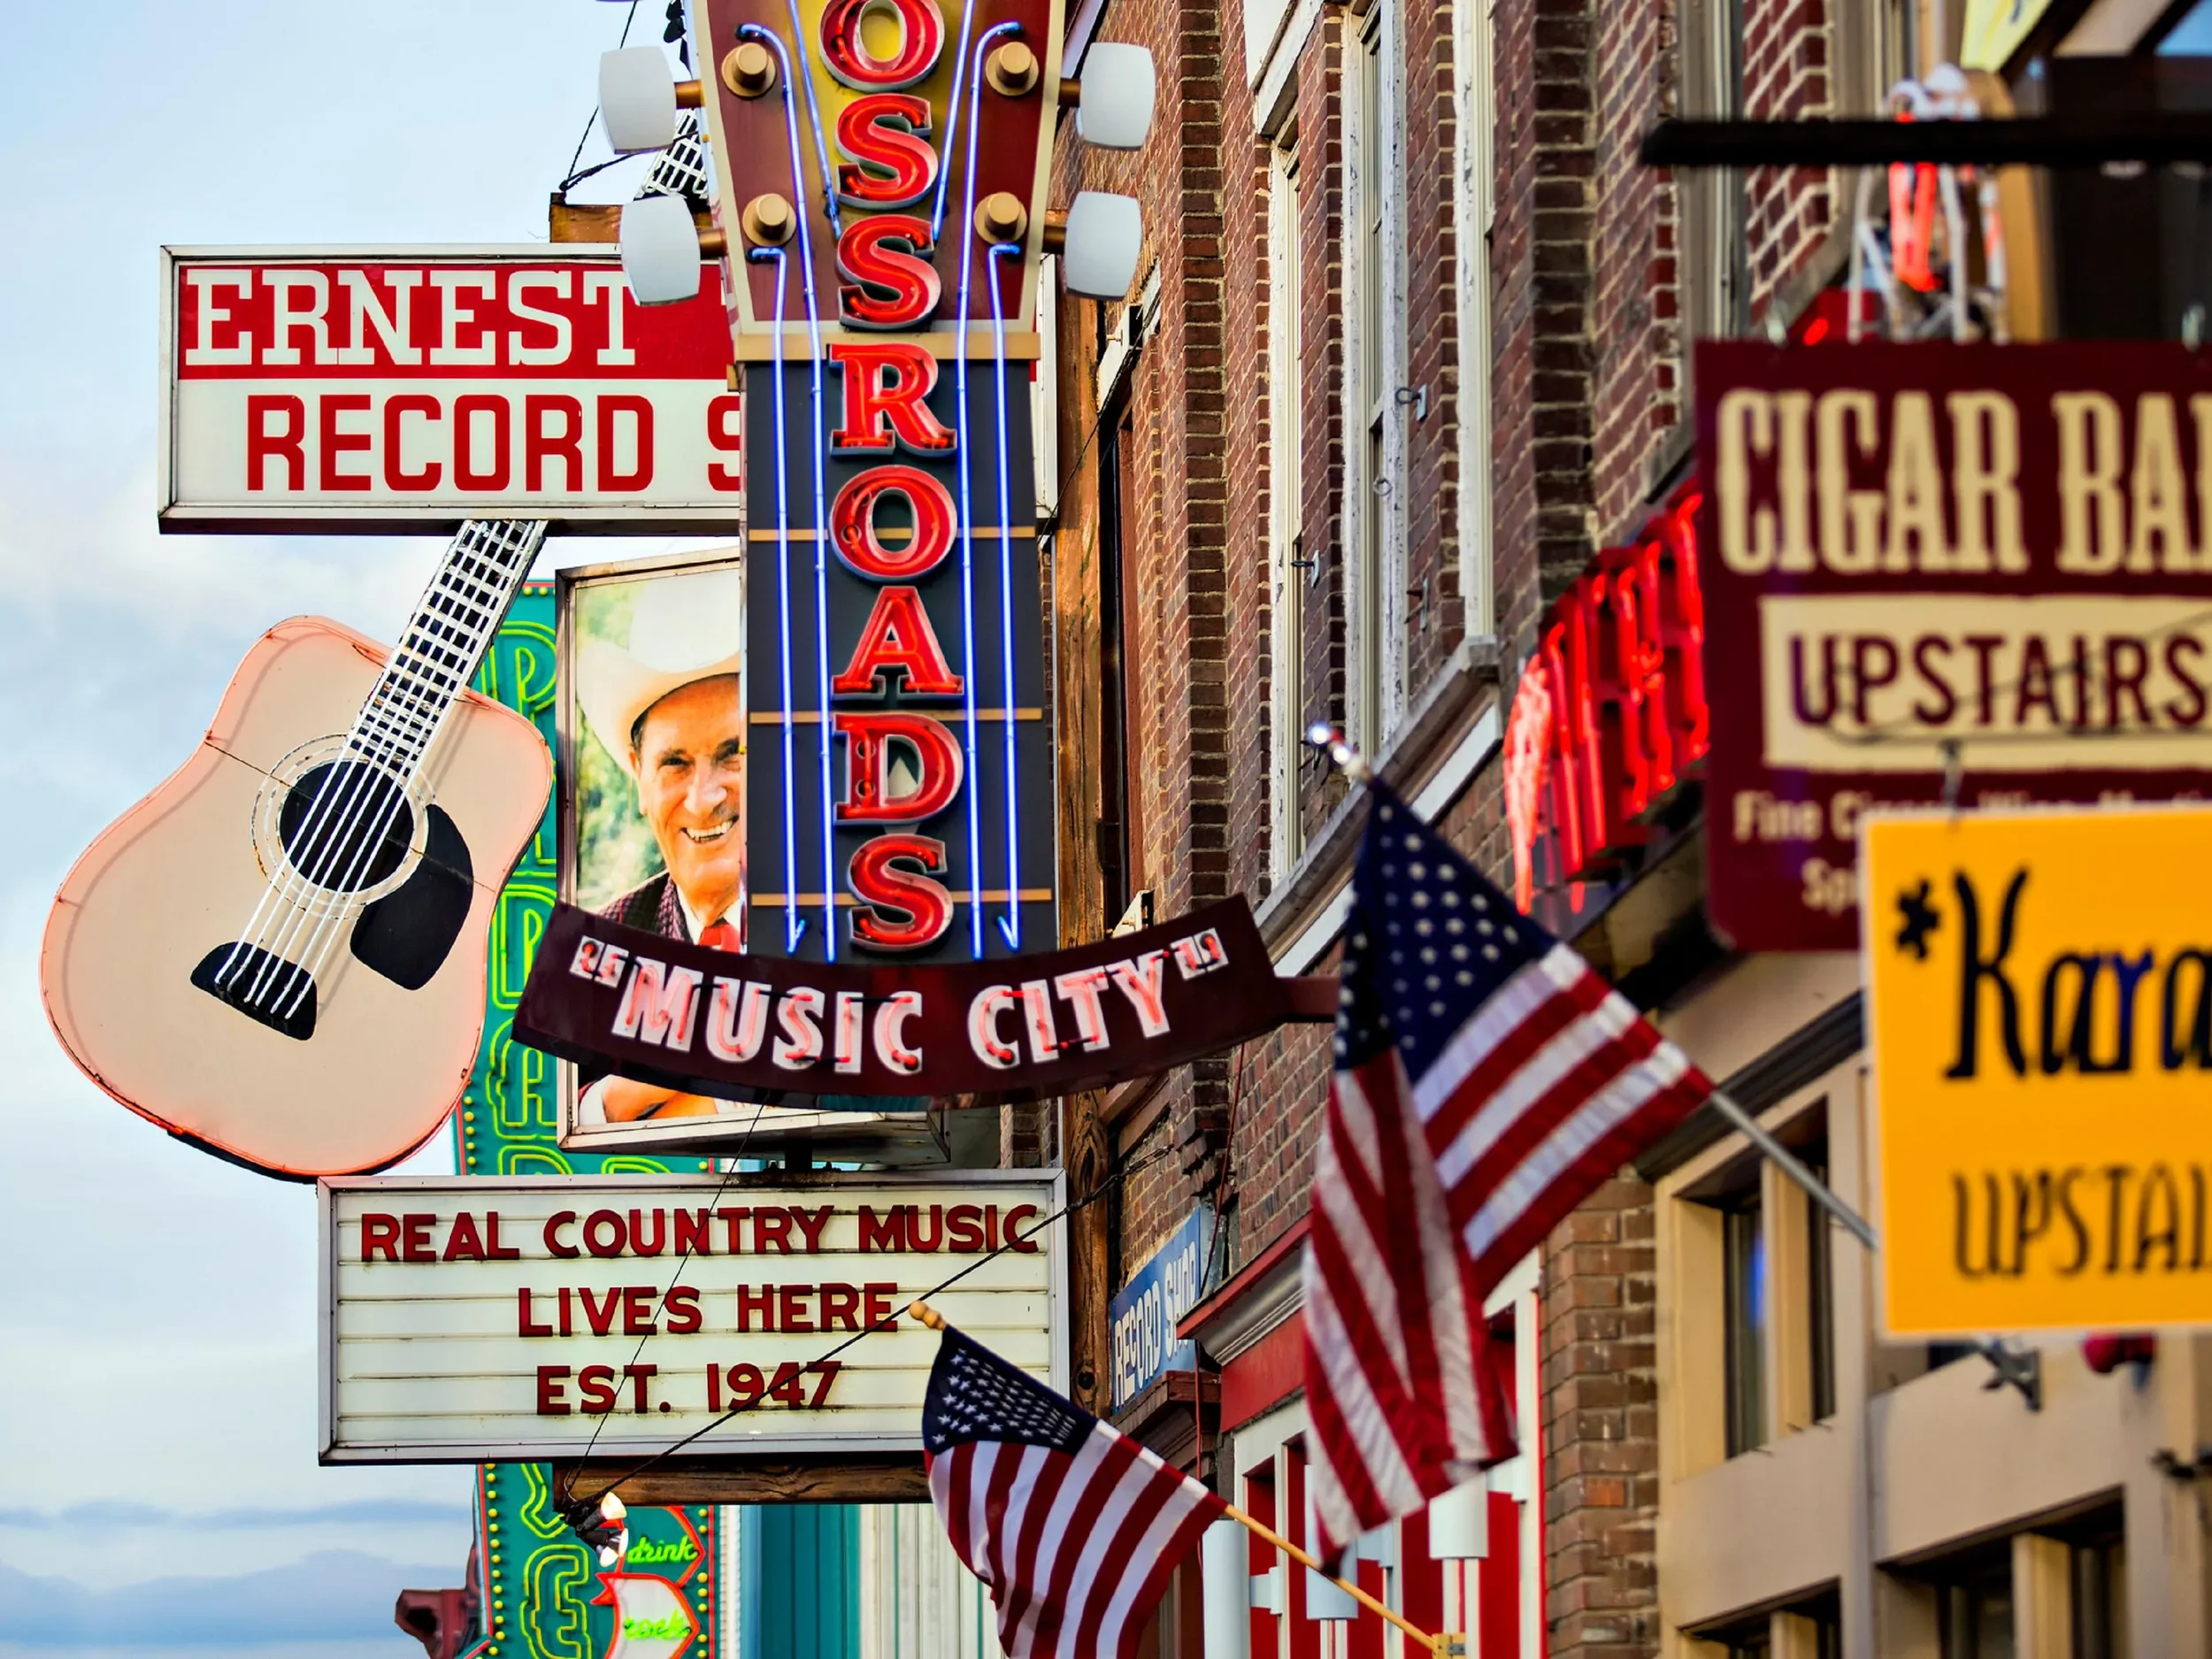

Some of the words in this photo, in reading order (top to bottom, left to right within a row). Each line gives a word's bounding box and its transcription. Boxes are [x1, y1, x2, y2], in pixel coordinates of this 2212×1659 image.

[185, 268, 636, 366] ERNEST
[246, 394, 655, 492] RECORD
[1716, 386, 2032, 576] CIGAR
[1788, 632, 2208, 728] UPSTAIRS
[360, 1210, 520, 1263] REAL
[542, 1204, 835, 1260] COUNTRY
[857, 1203, 1041, 1255] MUSIC
[517, 1286, 703, 1338] LIVES
[736, 1282, 899, 1333] HERE
[1115, 1280, 1161, 1407] RECORD
[536, 1364, 672, 1416] EST.
[707, 1361, 843, 1412] 1947
[627, 1536, 697, 1563] drink
